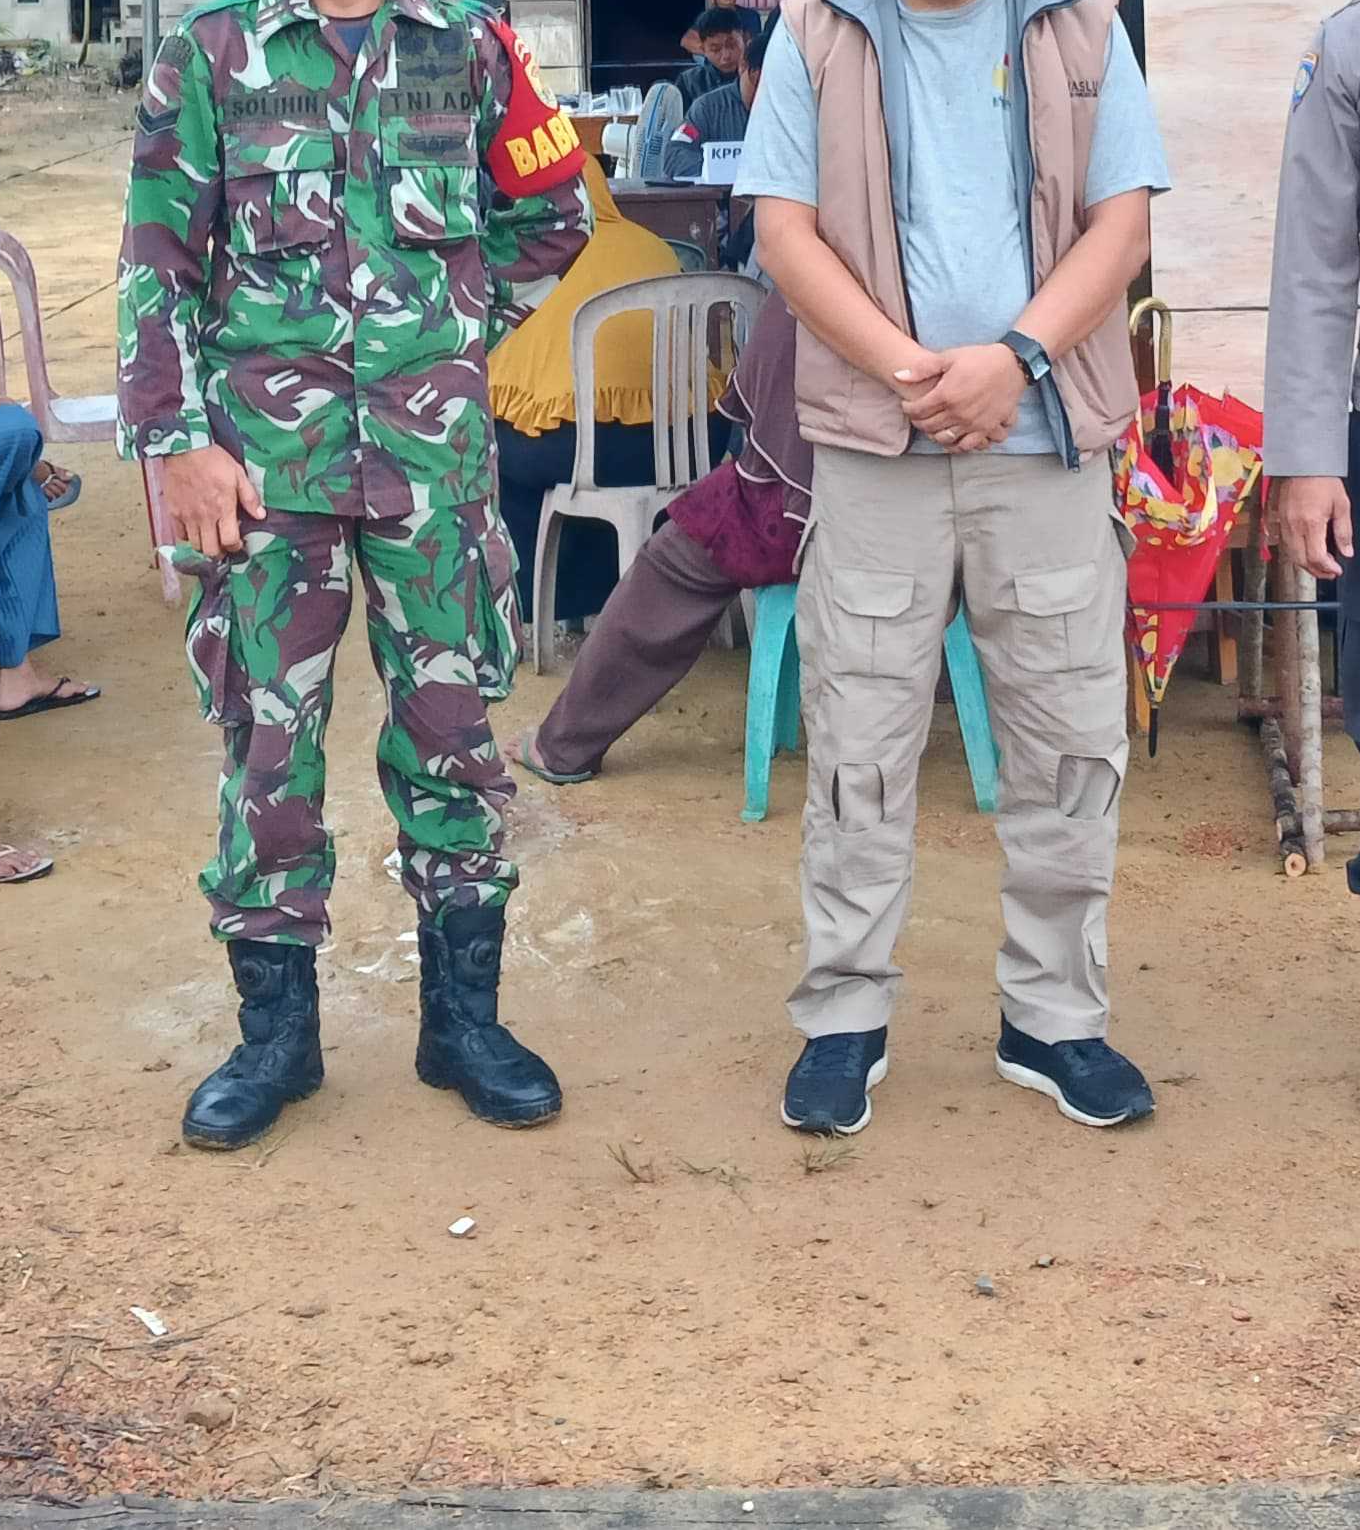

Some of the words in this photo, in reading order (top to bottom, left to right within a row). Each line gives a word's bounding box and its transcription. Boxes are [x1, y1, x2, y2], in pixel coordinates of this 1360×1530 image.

[1067, 79, 1099, 92] ASLU
[232, 94, 319, 117] SOLIHIN
[391, 92, 431, 110] TNI
[443, 89, 473, 111] AD
[711, 147, 742, 160] KPP
